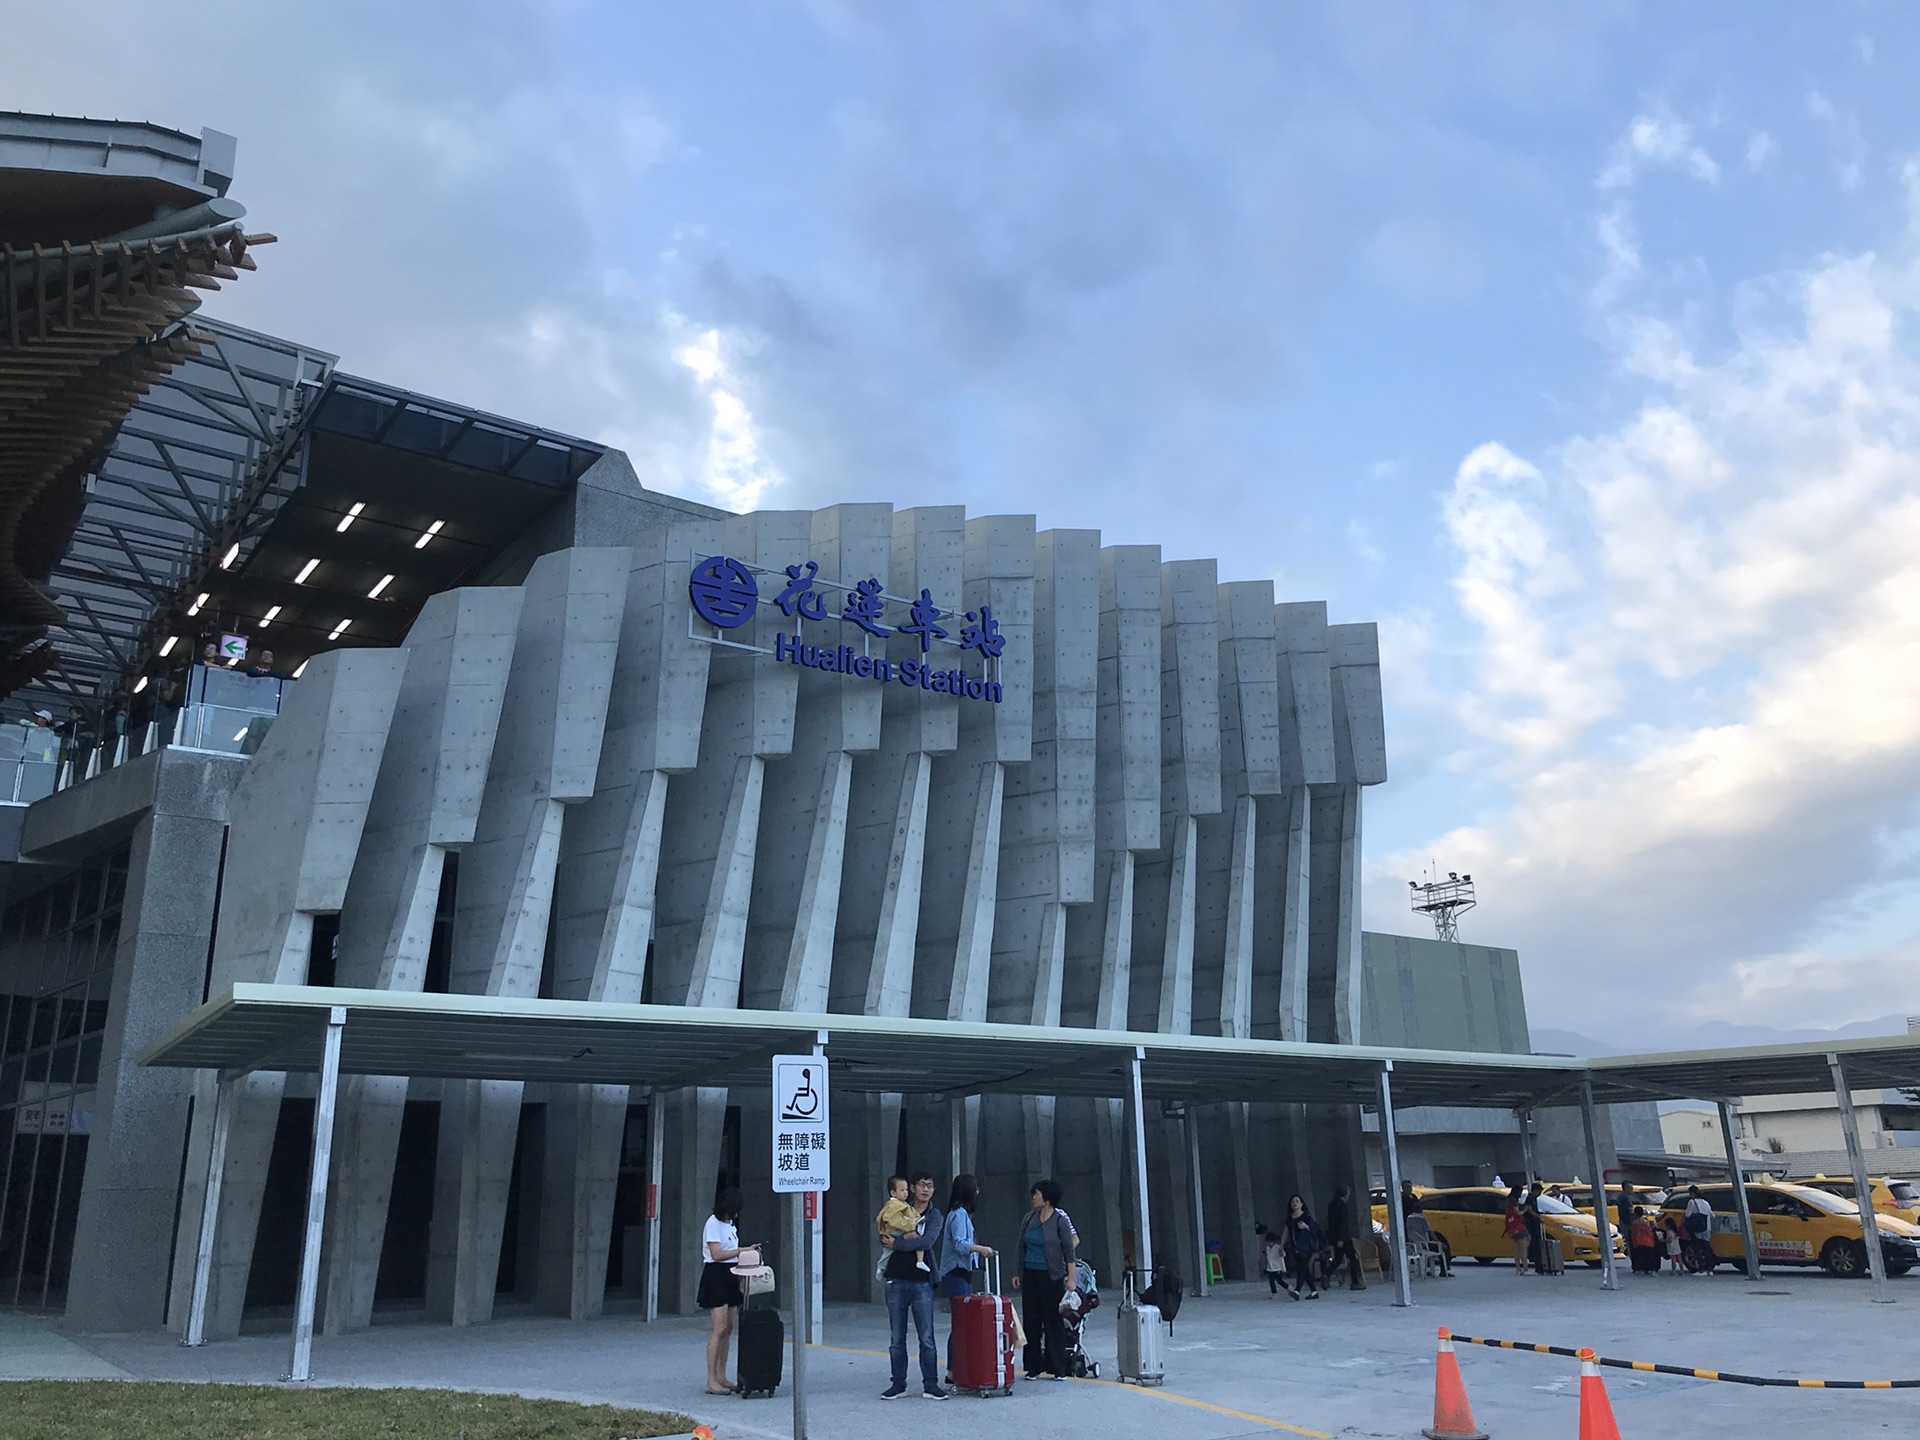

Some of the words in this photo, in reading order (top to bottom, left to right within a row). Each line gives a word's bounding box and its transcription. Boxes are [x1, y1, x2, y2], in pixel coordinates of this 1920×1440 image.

[773, 561, 1006, 658] 花蓮車站
[776, 632, 893, 681] Hualien
[899, 658, 1003, 703] Station
[778, 1132, 826, 1151] 無障礙
[778, 1153, 810, 1171] 坡道
[778, 1177, 809, 1186] Wheelchair
[810, 1176, 826, 1187] Ramp
